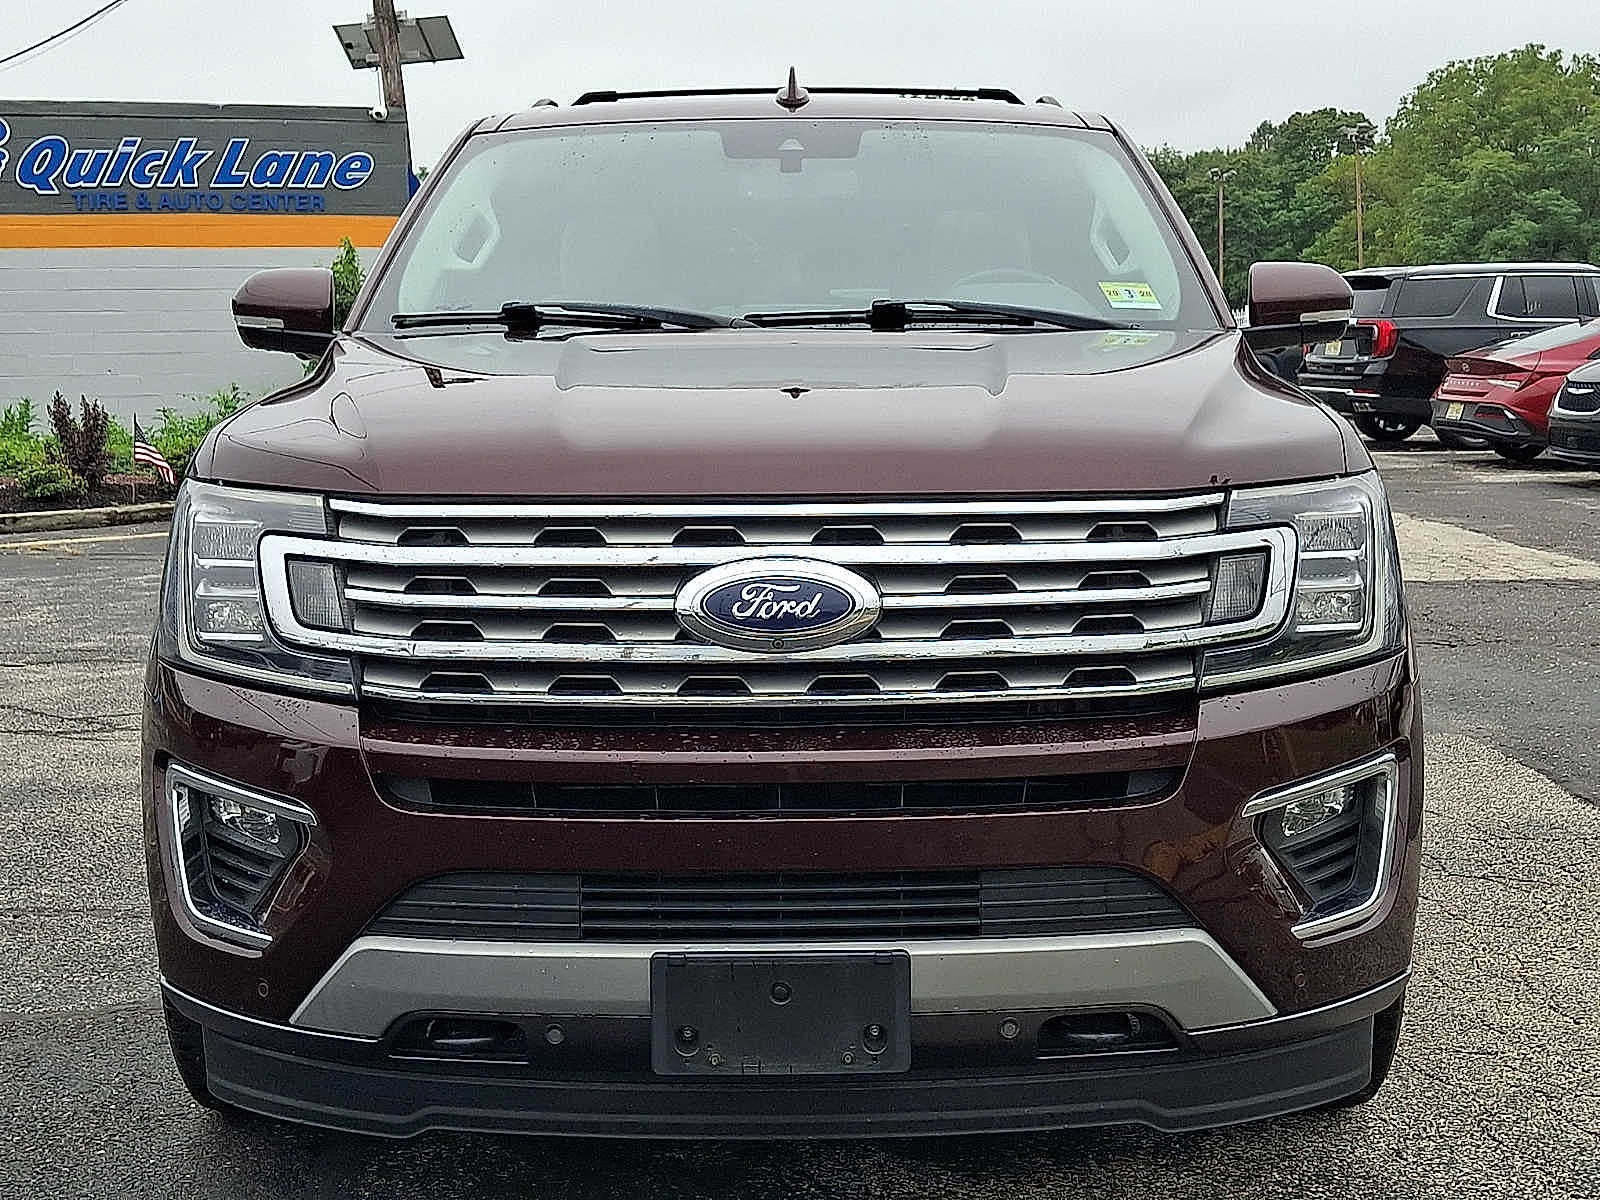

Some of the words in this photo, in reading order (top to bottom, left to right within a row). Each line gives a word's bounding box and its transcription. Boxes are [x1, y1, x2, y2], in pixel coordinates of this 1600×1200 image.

[15, 136, 215, 195] Quick
[210, 137, 375, 190] Lane
[72, 191, 129, 211] TIRE
[135, 191, 152, 211] &
[157, 192, 224, 211] AUTO
[230, 192, 325, 211] CENTER
[731, 582, 823, 620] Ford
